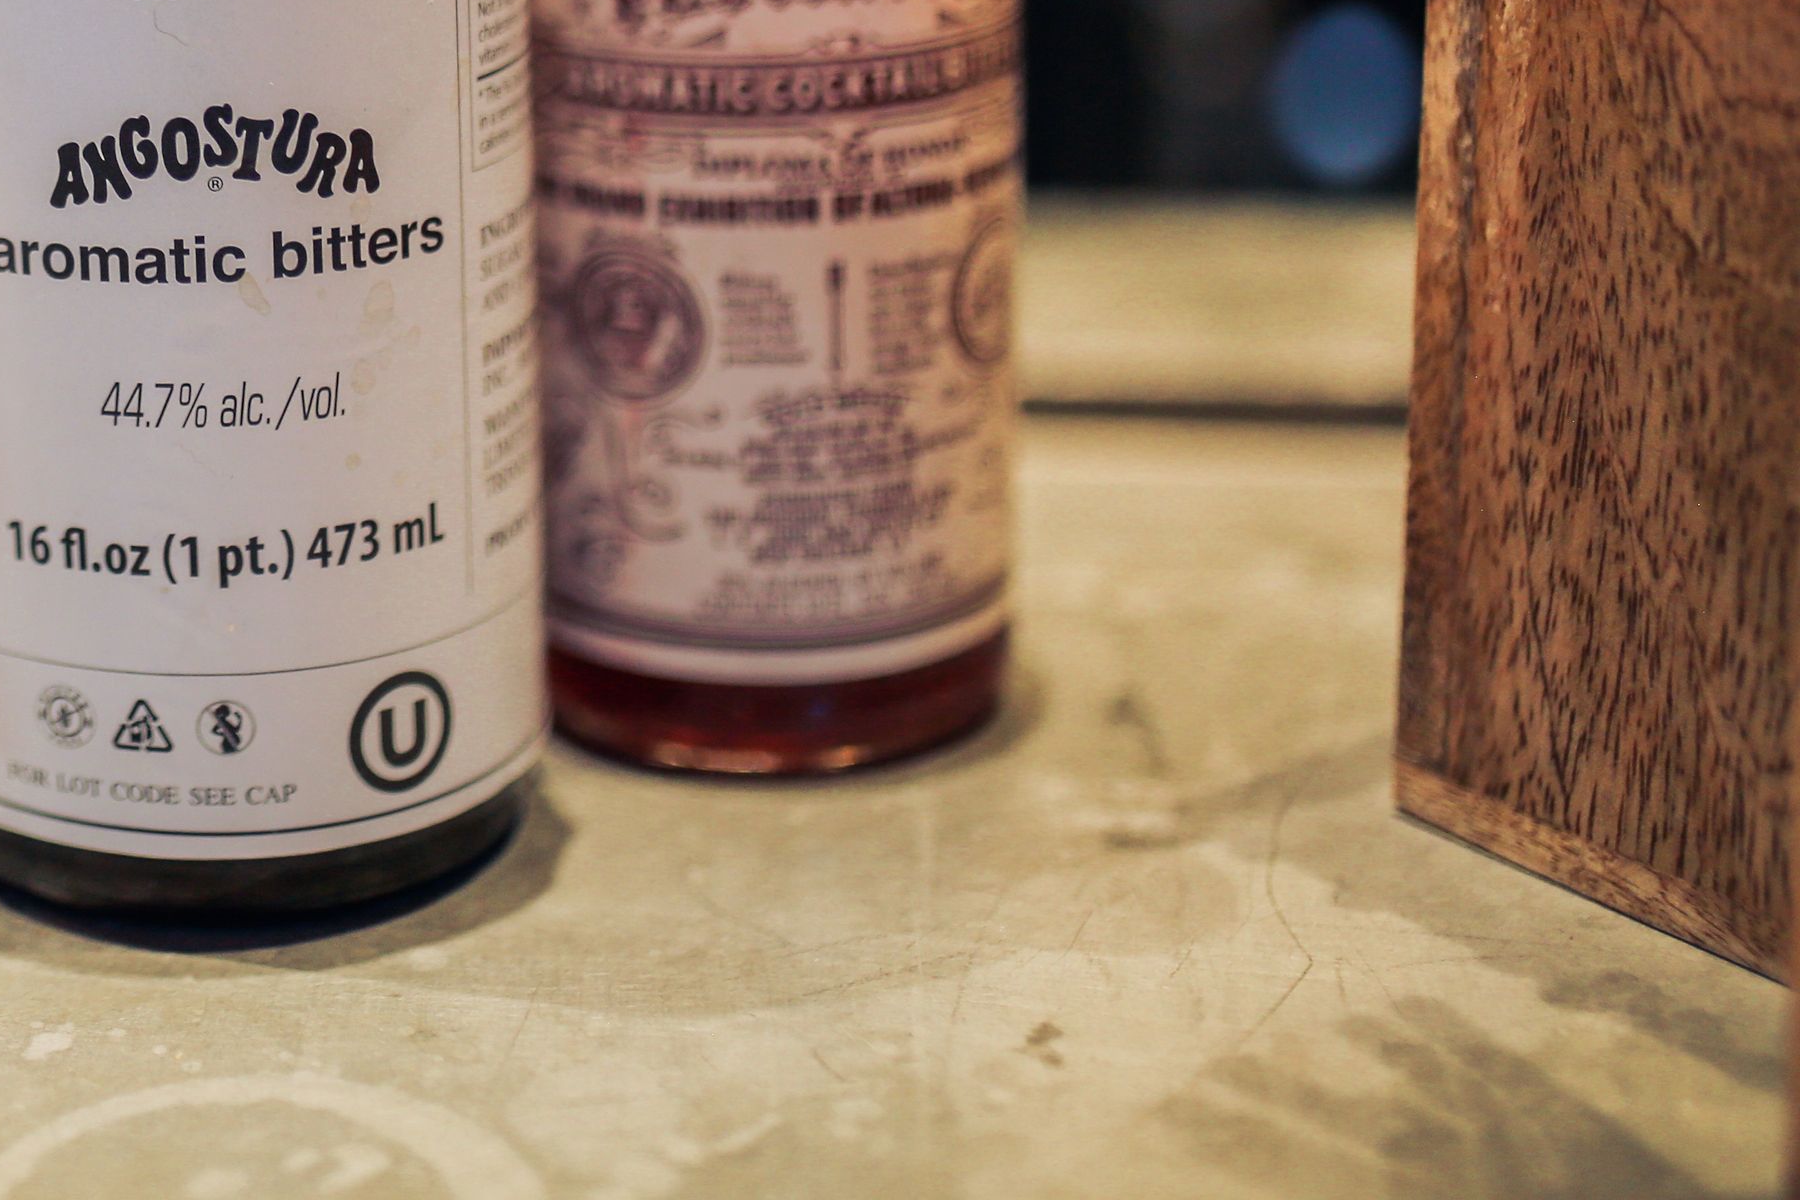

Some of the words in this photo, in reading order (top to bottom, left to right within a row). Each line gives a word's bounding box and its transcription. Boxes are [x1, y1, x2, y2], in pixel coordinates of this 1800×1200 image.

[50, 103, 381, 209] ANGOSTURA
[272, 216, 445, 279] bitters
[100, 381, 209, 429] 44.7%
[8, 520, 51, 566] 16
[61, 526, 151, 577] fl.oz
[163, 532, 200, 585] (1
[217, 528, 296, 589] pt.)
[306, 518, 381, 569] 473
[393, 501, 446, 555] mL
[56, 772, 103, 799] LOT
[109, 781, 179, 806] CODE
[188, 785, 238, 807] SEE
[244, 783, 298, 806] CAP
